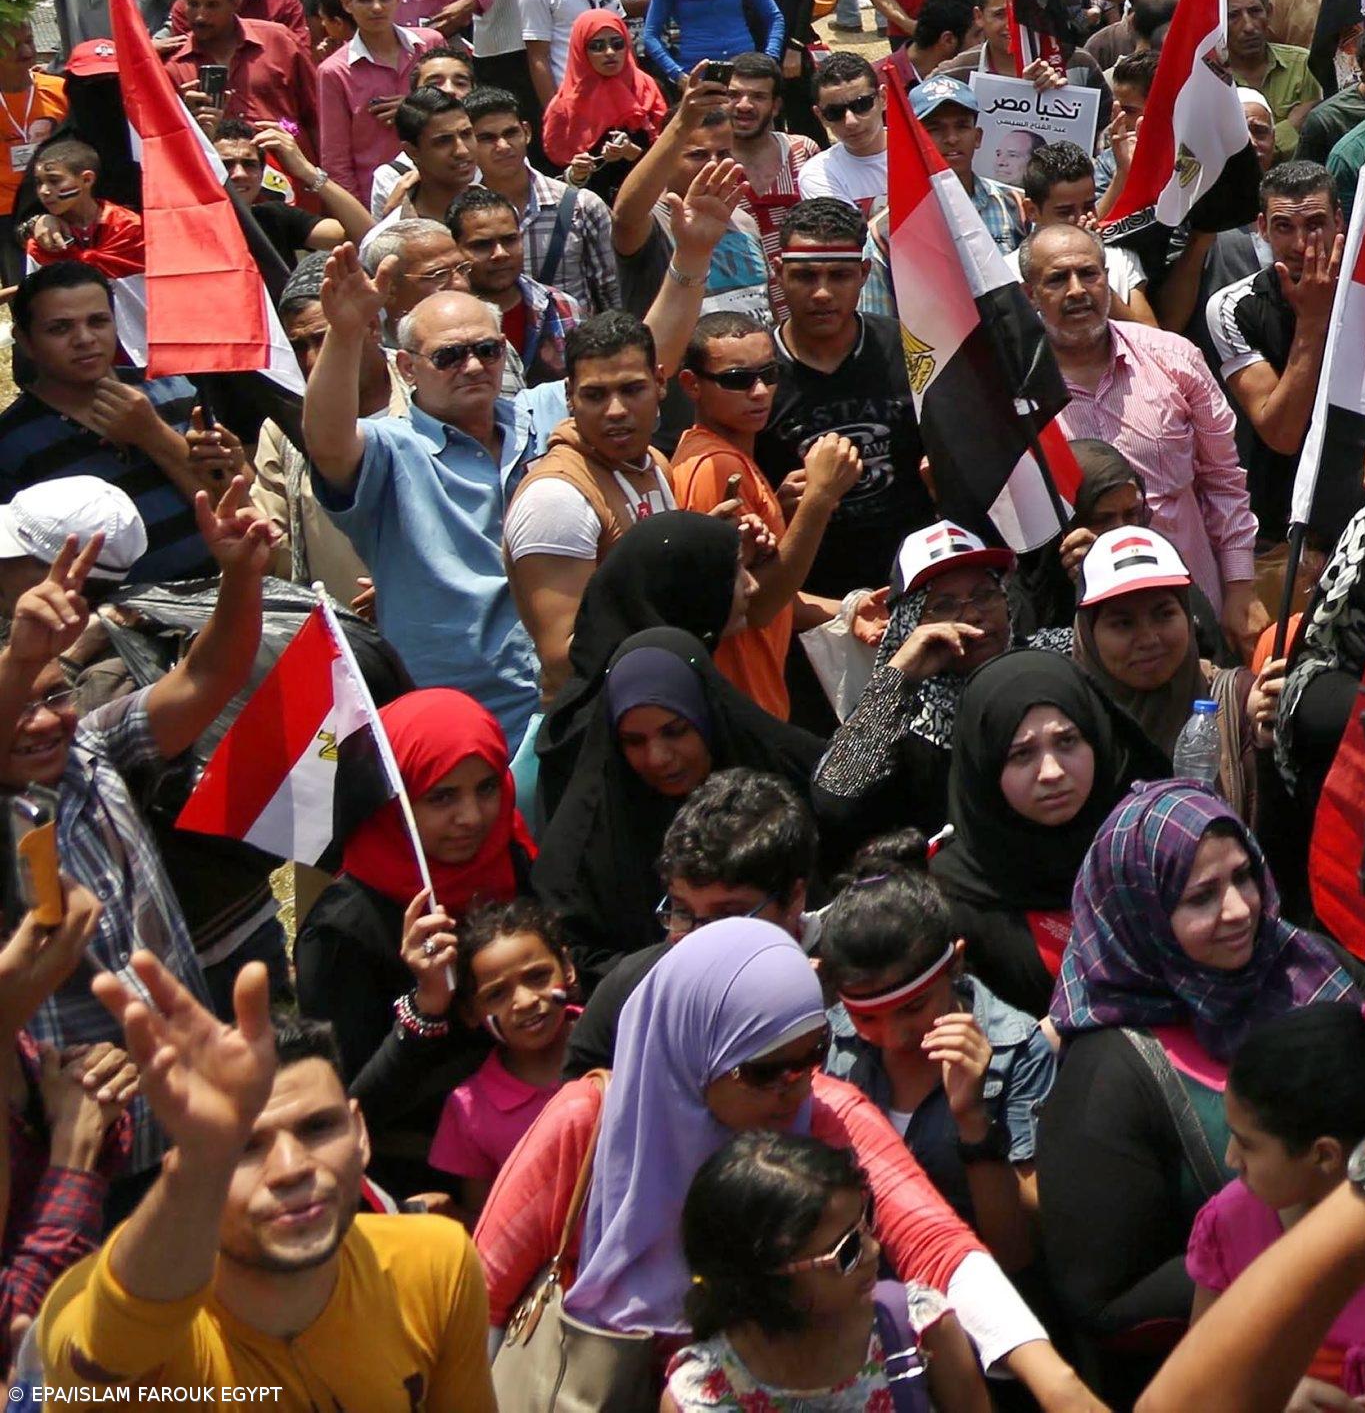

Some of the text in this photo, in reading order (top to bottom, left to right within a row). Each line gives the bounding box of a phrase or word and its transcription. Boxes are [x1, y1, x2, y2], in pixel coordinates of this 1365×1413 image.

[984, 91, 1082, 121] تحيا مصر
[1029, 122, 1052, 132] الفتاح
[1053, 125, 1067, 134] عبد
